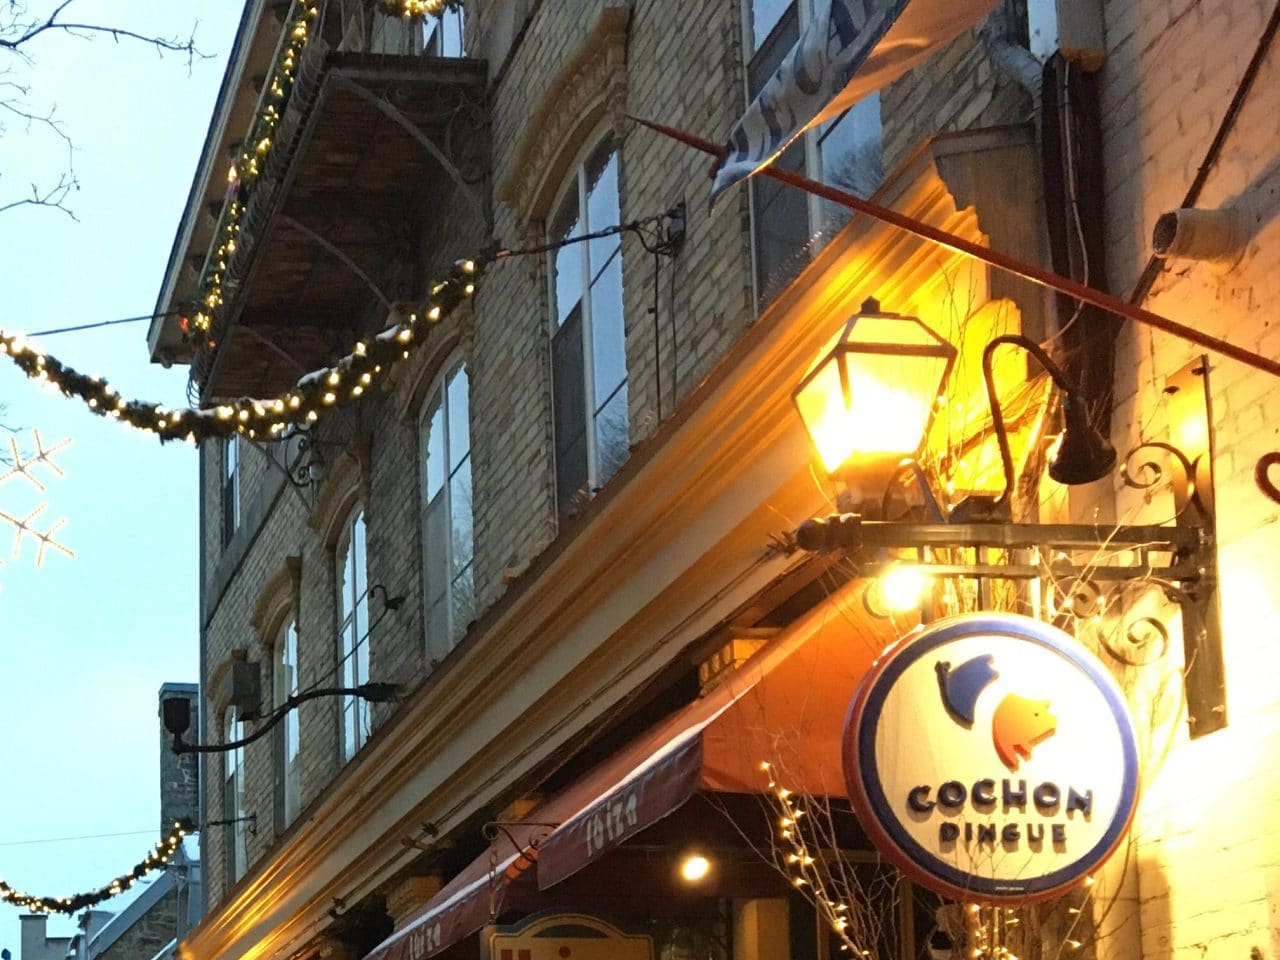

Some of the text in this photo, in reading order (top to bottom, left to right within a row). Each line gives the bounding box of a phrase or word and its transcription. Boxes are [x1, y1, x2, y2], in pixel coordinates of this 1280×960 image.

[906, 778, 1093, 820] COCHON
[586, 792, 638, 858] Ibiza
[939, 822, 1067, 848] DINGUE
